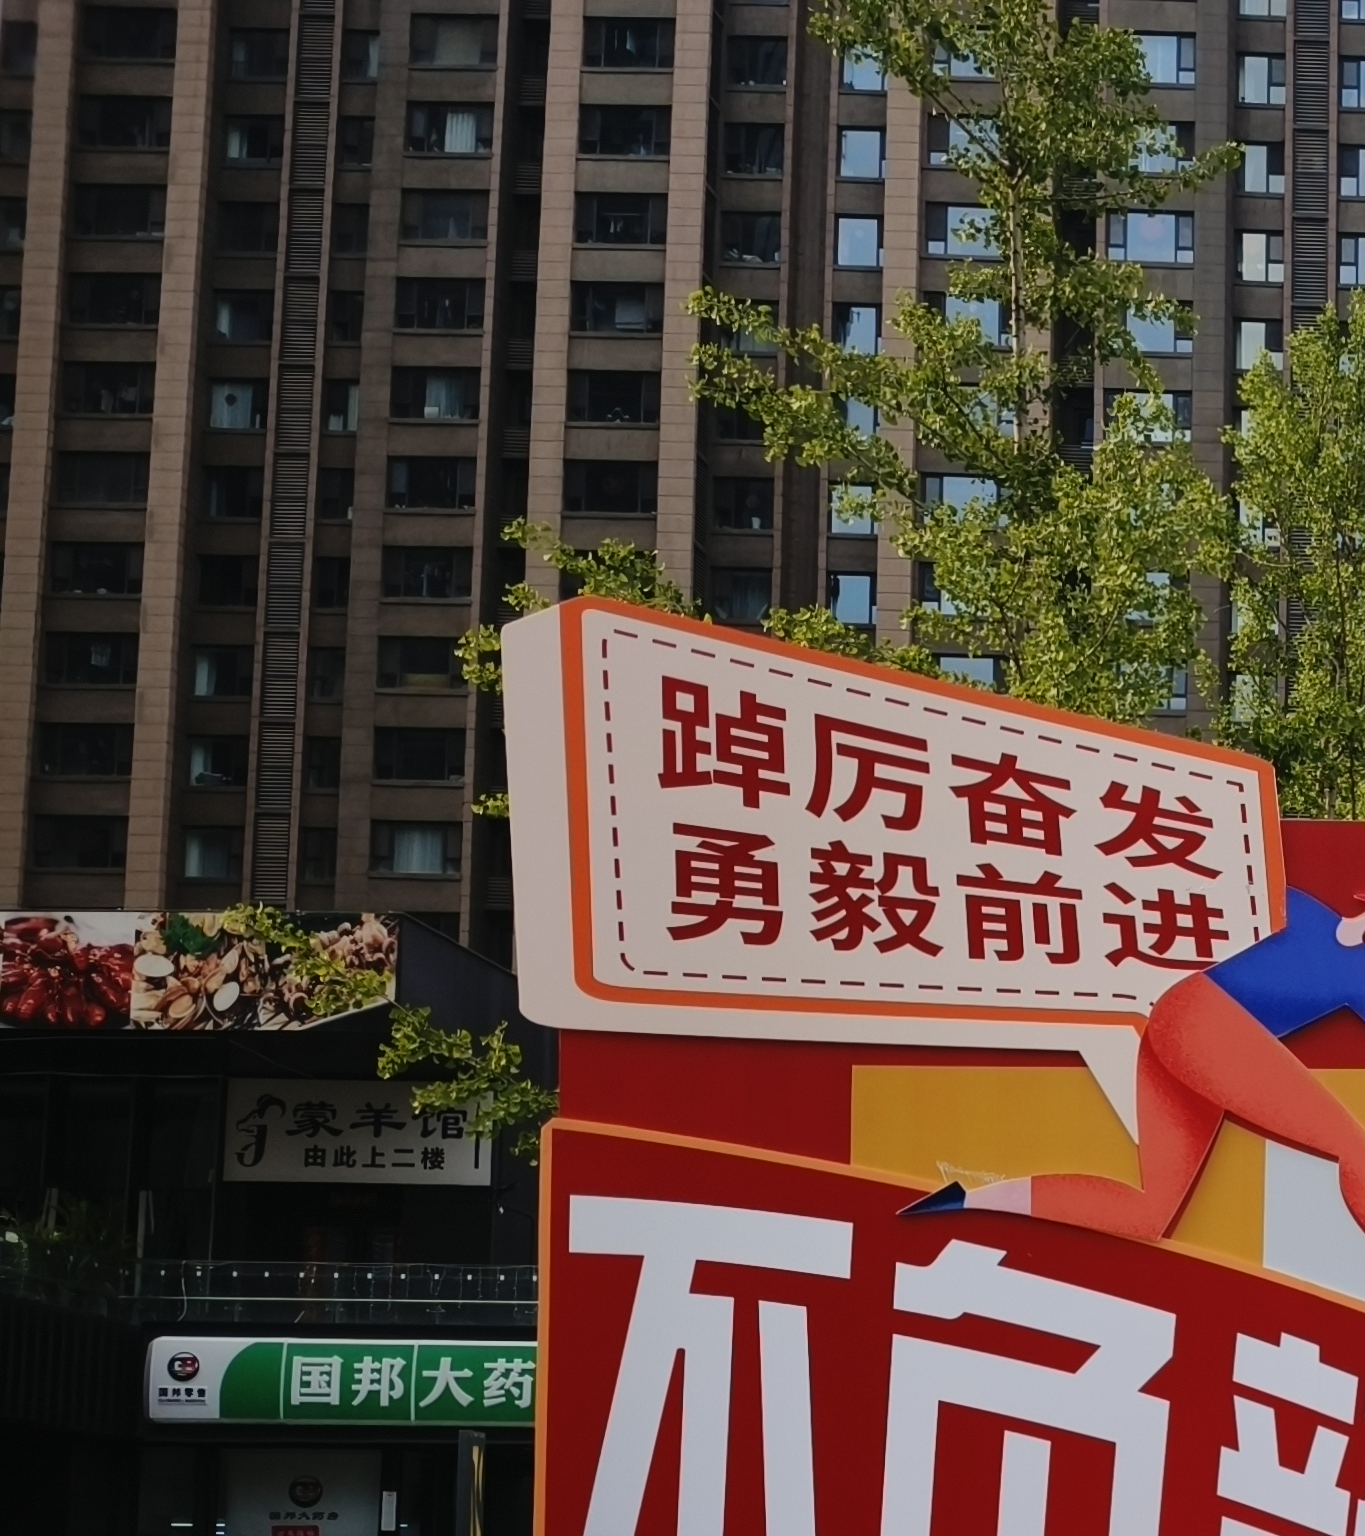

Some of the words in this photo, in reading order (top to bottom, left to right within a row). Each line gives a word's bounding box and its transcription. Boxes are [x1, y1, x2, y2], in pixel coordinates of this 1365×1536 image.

[657, 675, 1224, 880] 踔厉奋发
[666, 822, 1230, 969] 勇毅前进
[303, 1144, 446, 1171] 由此上二楼
[290, 1354, 537, 1409] 国邦大药
